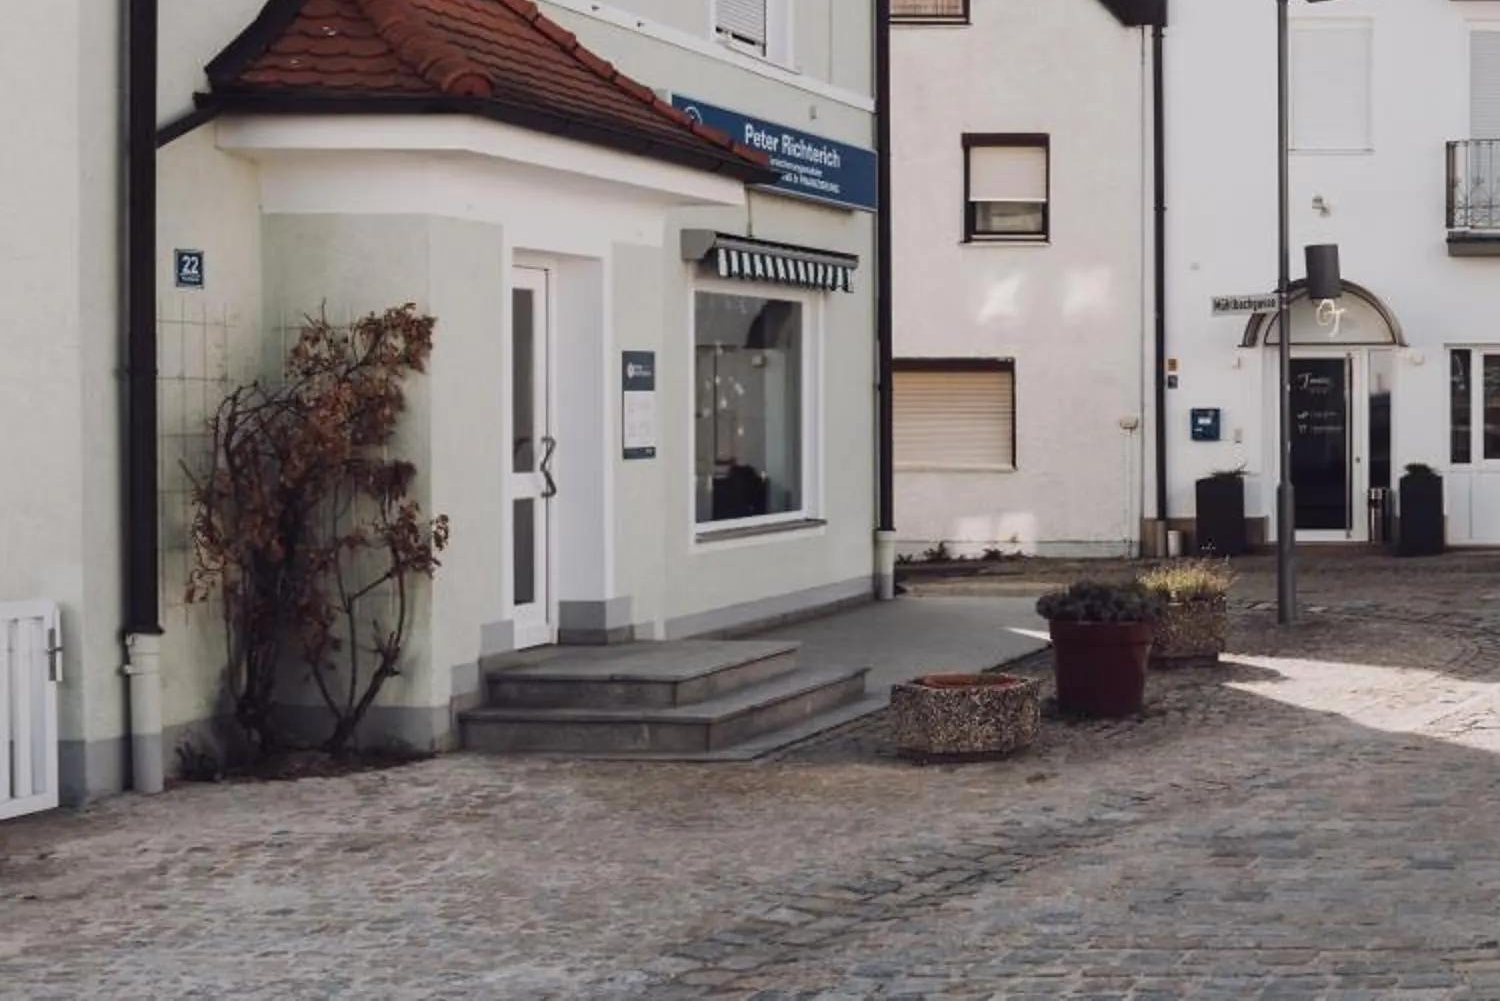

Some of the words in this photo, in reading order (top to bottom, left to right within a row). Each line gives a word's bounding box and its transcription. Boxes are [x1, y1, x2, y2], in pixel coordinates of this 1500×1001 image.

[745, 122, 779, 151] Peter
[781, 134, 841, 168] Richterich
[181, 254, 199, 274] 22
